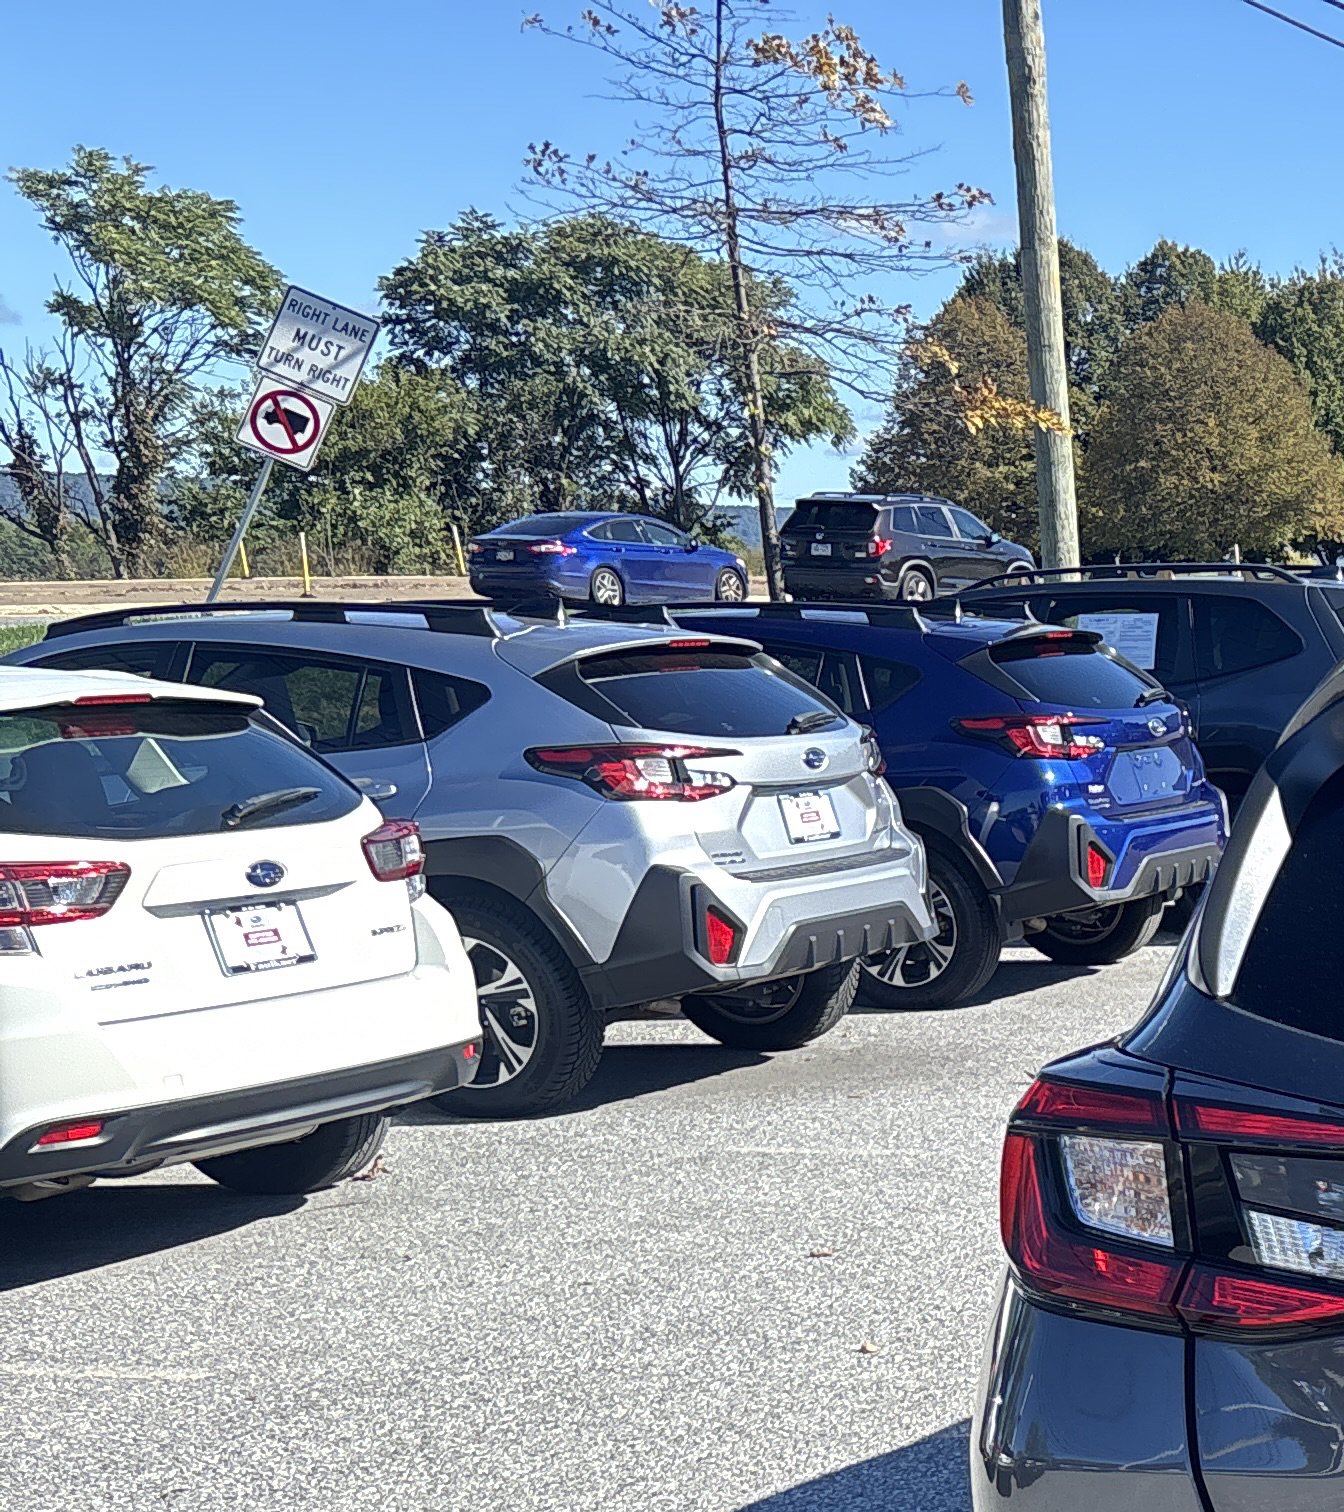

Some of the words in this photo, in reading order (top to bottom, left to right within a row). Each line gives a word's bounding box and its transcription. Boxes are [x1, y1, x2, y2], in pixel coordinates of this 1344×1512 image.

[286, 298, 331, 326] RIGHT
[332, 316, 370, 344] LANE
[292, 327, 345, 361] MUST
[267, 345, 305, 372] TURN
[306, 363, 351, 391] RIGHT
